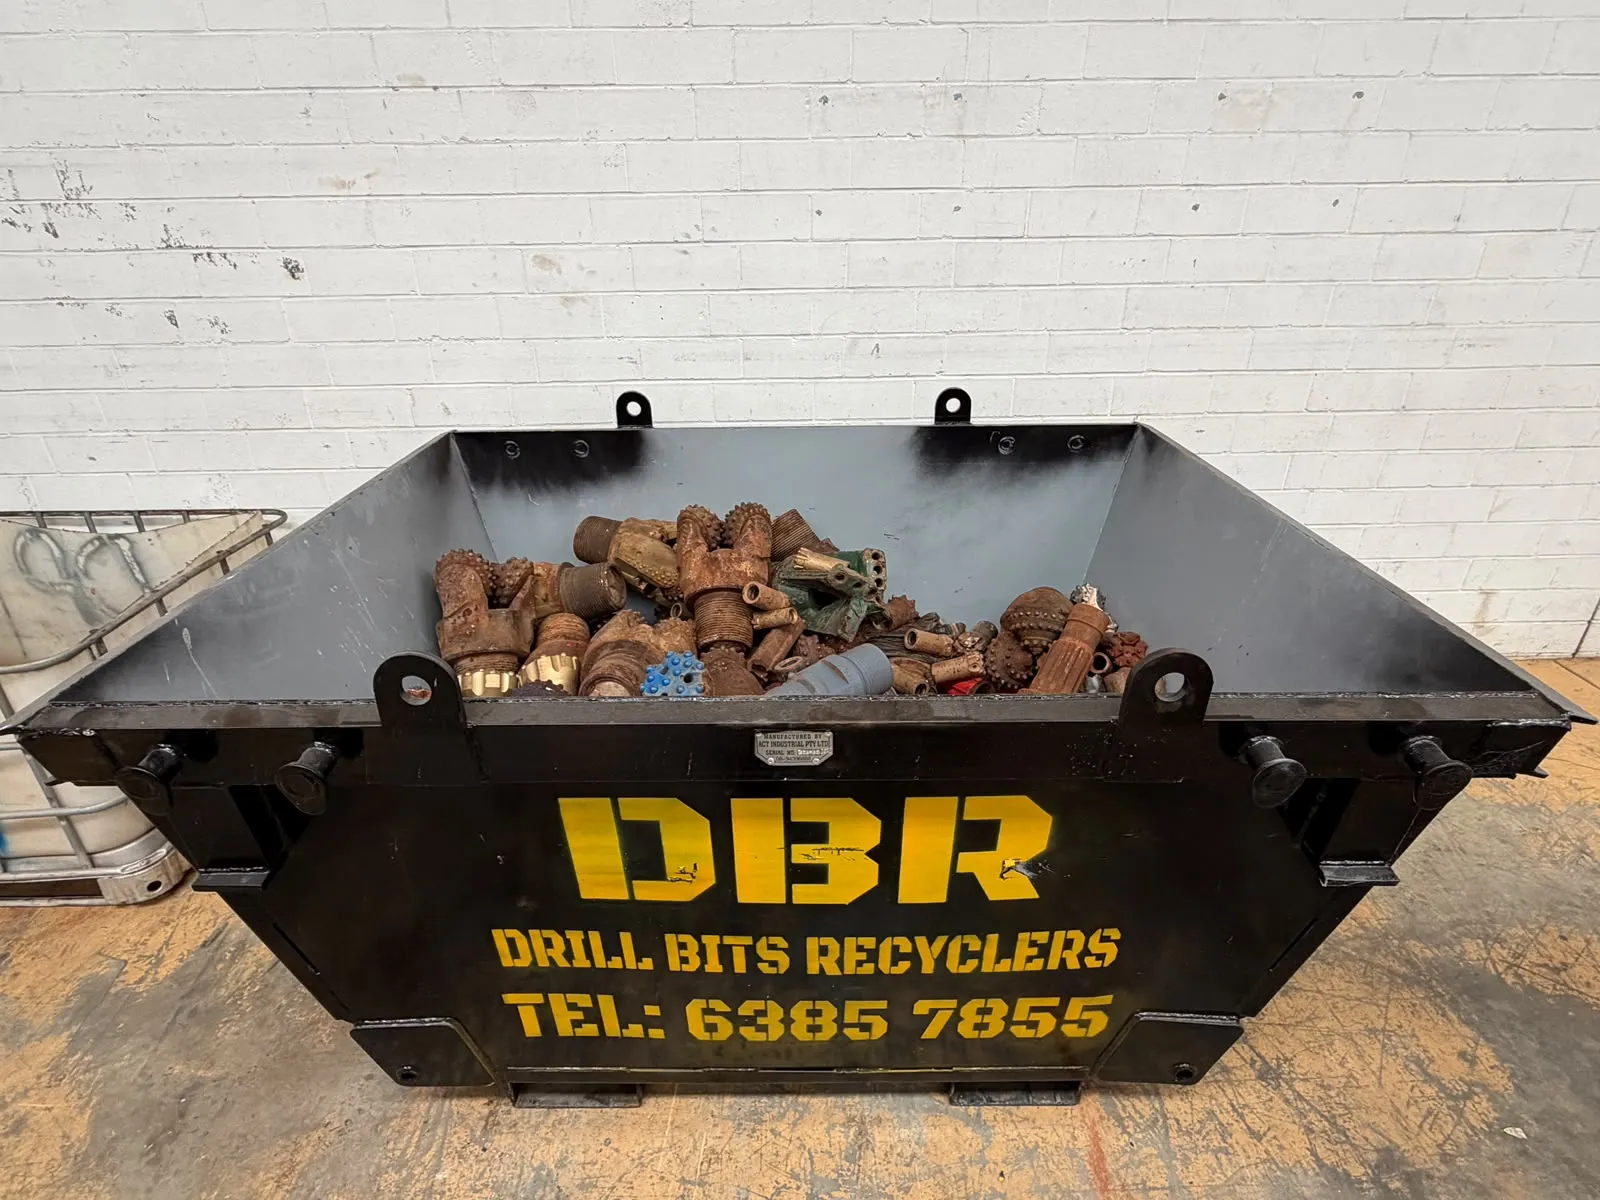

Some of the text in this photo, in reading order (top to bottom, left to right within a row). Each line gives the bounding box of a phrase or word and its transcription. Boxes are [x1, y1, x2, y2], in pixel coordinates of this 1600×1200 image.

[770, 740, 804, 748] INDUSTRIAL
[805, 740, 816, 748] PTY
[558, 795, 1054, 906] DBR
[491, 927, 1122, 976] DRILL BITS RECYCLERS
[501, 992, 1114, 1042] TEL: 6385 7855
